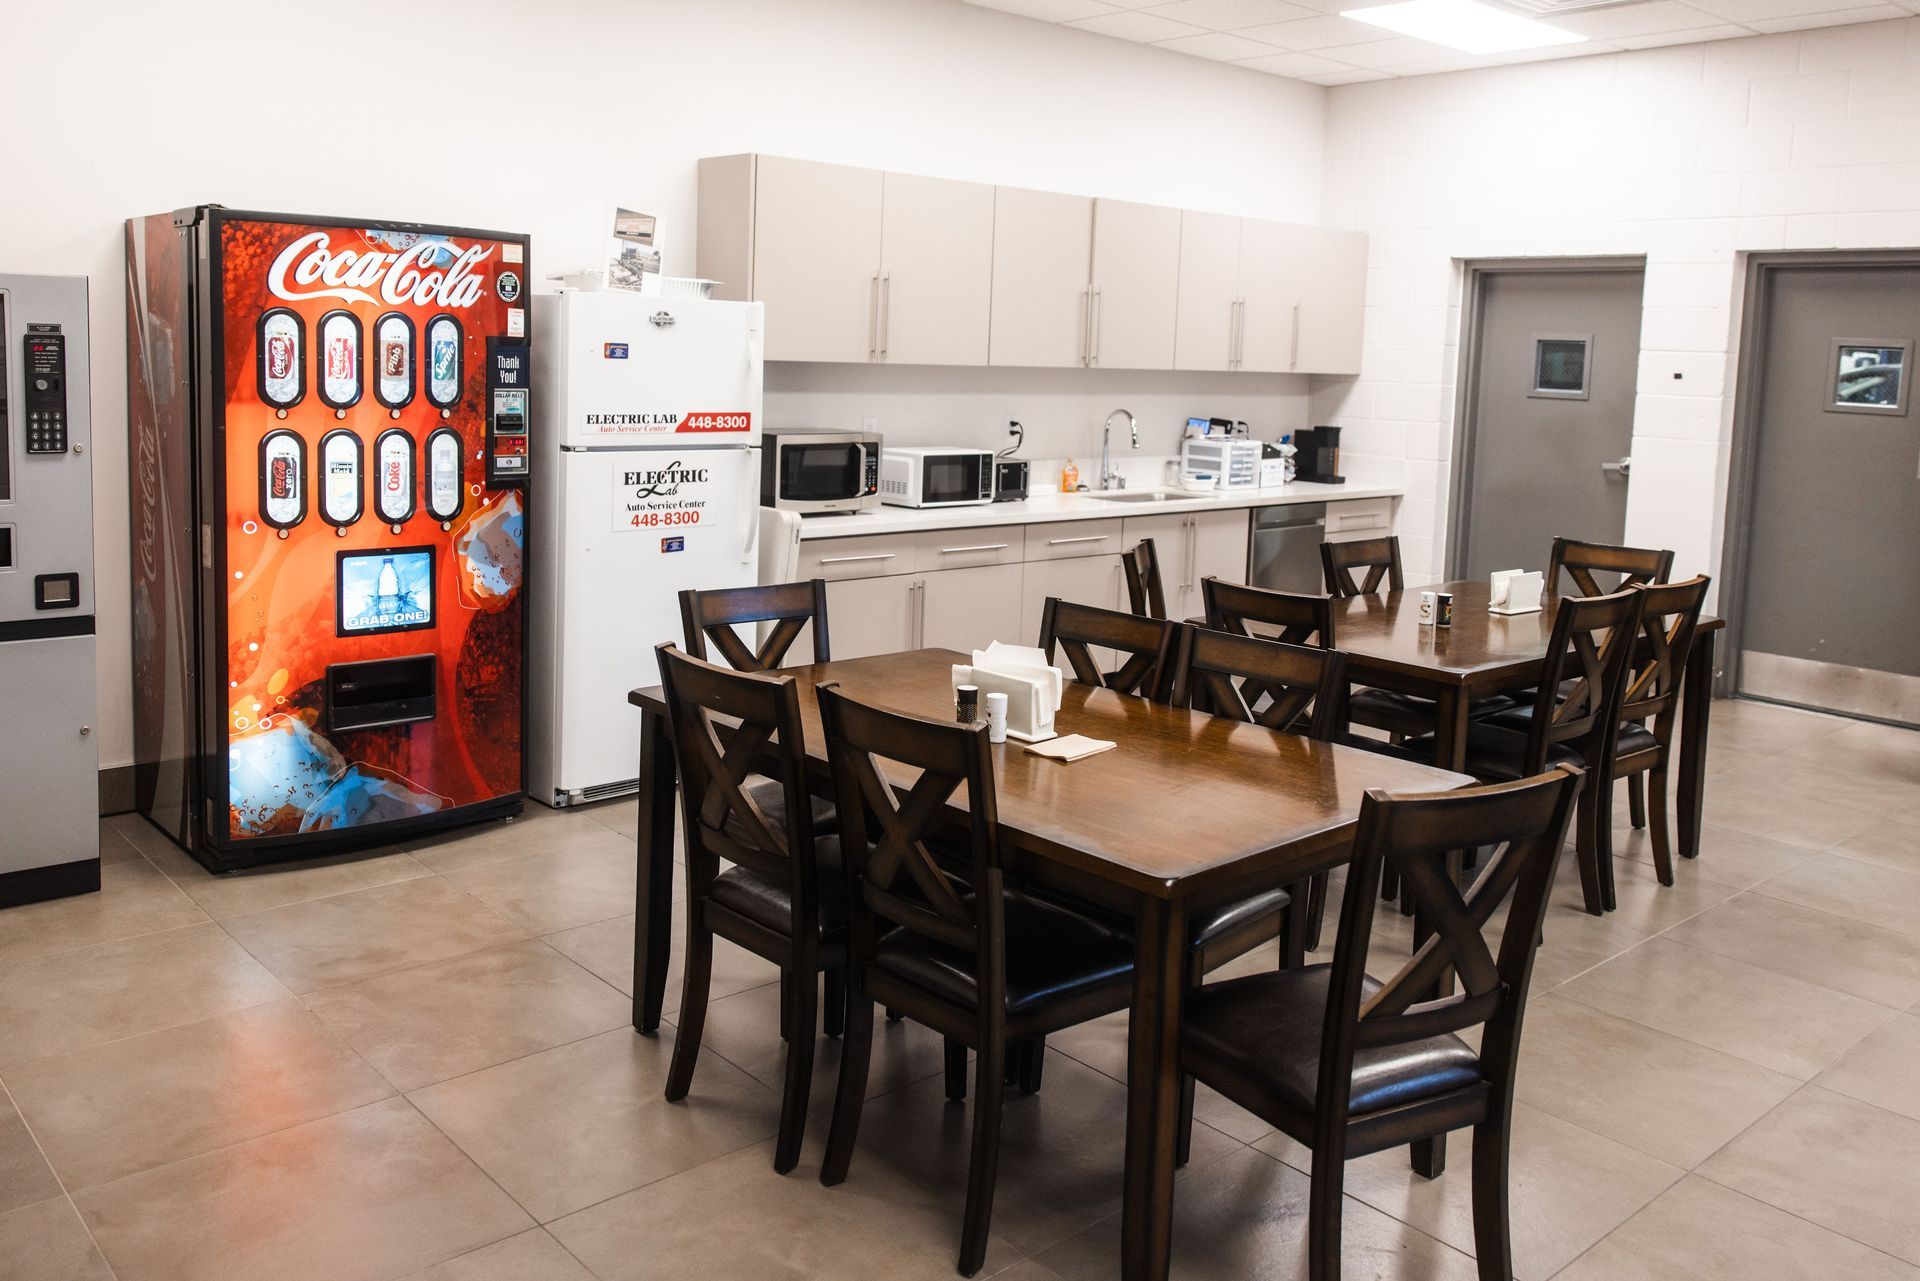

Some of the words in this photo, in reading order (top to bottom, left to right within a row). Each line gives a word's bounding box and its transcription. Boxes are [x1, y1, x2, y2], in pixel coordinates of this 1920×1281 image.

[267, 231, 496, 308] Coca-Cola
[435, 343, 455, 378] Sprite
[497, 355, 520, 369] Thank
[500, 370, 517, 384] You!
[494, 391, 511, 399] DOLLAR
[586, 413, 650, 425] ELECTRIC
[653, 413, 677, 424] LAB
[687, 415, 747, 429] 448-8300
[598, 425, 615, 433] Auto
[617, 425, 643, 433] Service
[272, 460, 286, 497] Coca-Cola
[387, 461, 401, 492] Coke
[623, 468, 708, 486] ELECTRIC
[625, 503, 645, 512] Auto
[646, 500, 678, 511] Service
[678, 499, 706, 509] Center
[631, 510, 700, 527] 448-8300
[348, 613, 390, 627] GRAB
[393, 610, 428, 623] ONE!
